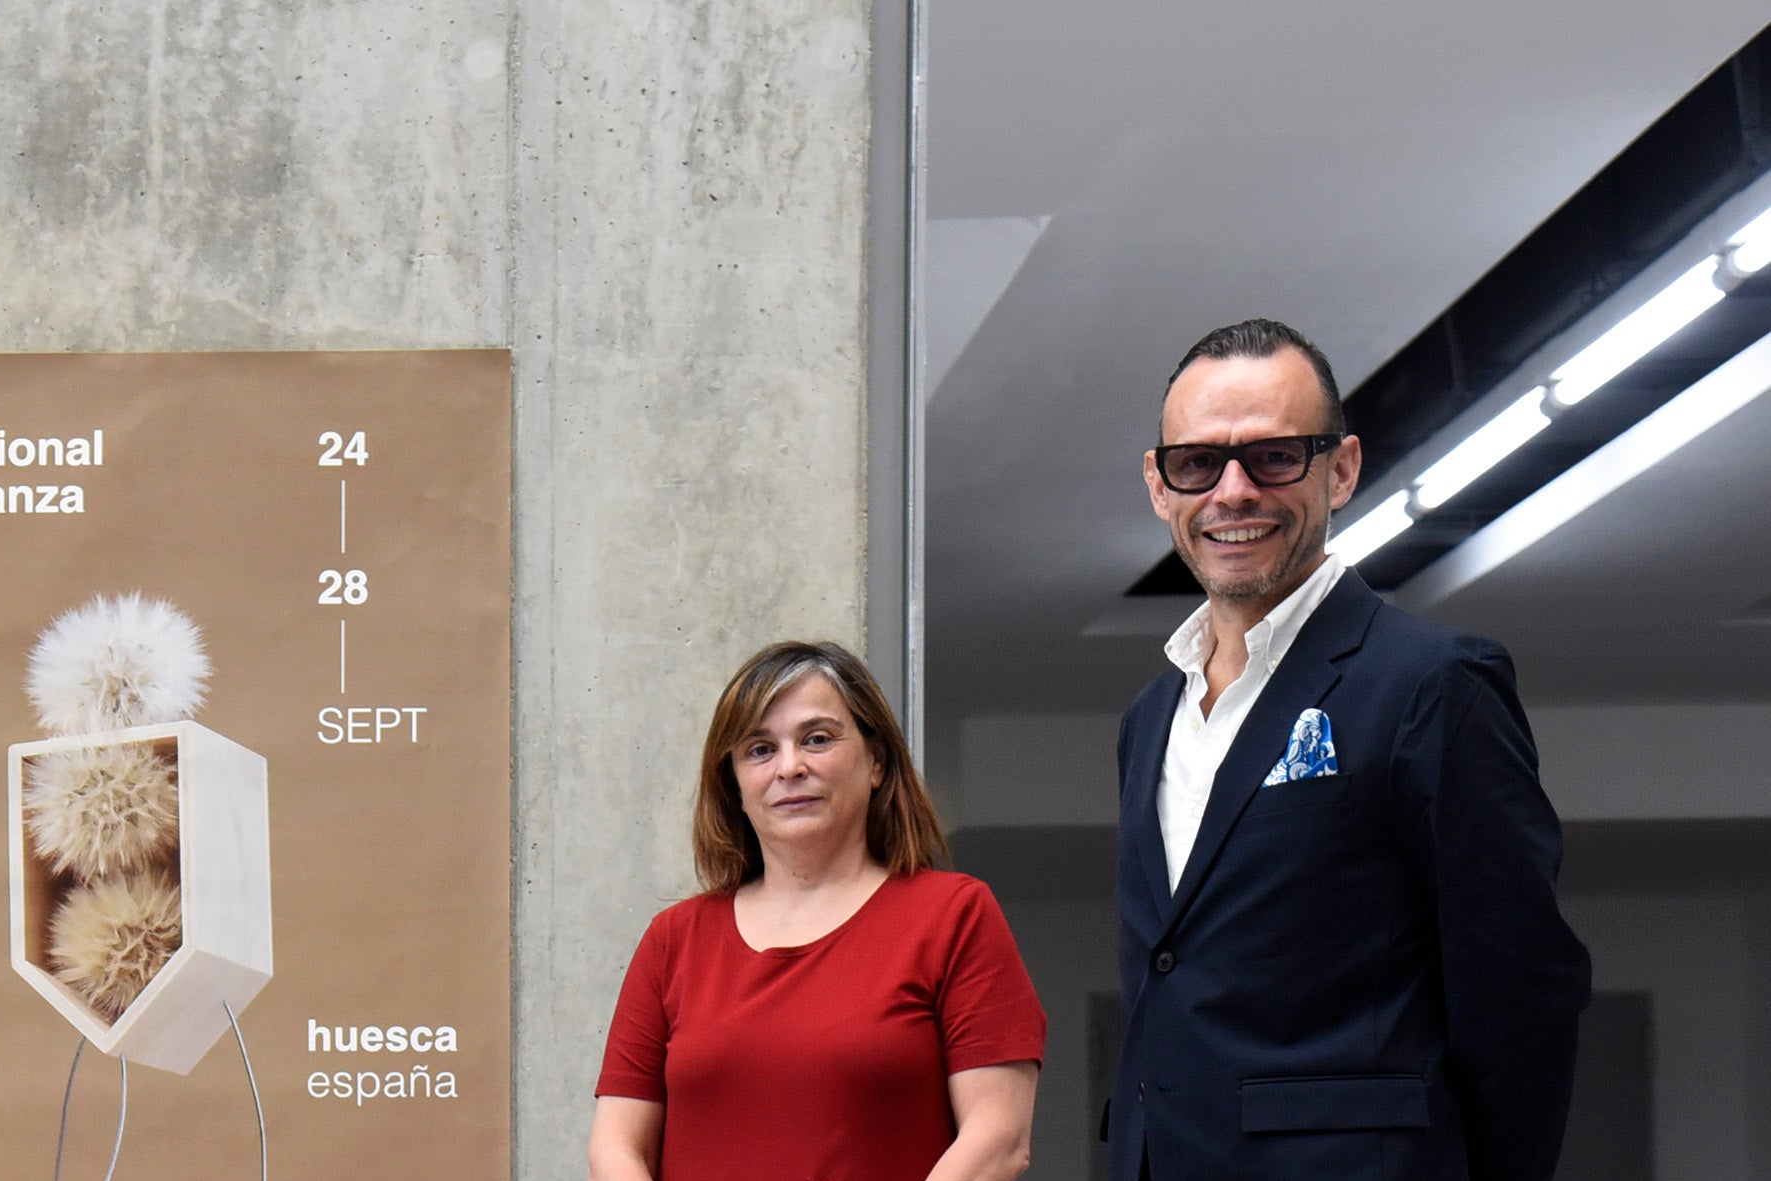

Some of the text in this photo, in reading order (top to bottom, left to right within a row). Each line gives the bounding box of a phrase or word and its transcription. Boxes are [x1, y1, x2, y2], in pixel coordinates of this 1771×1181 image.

[318, 431, 369, 466] 24
[317, 569, 369, 605] 28
[317, 706, 428, 744] SEPT
[307, 1018, 458, 1052] huesca
[307, 1064, 459, 1107] españa
